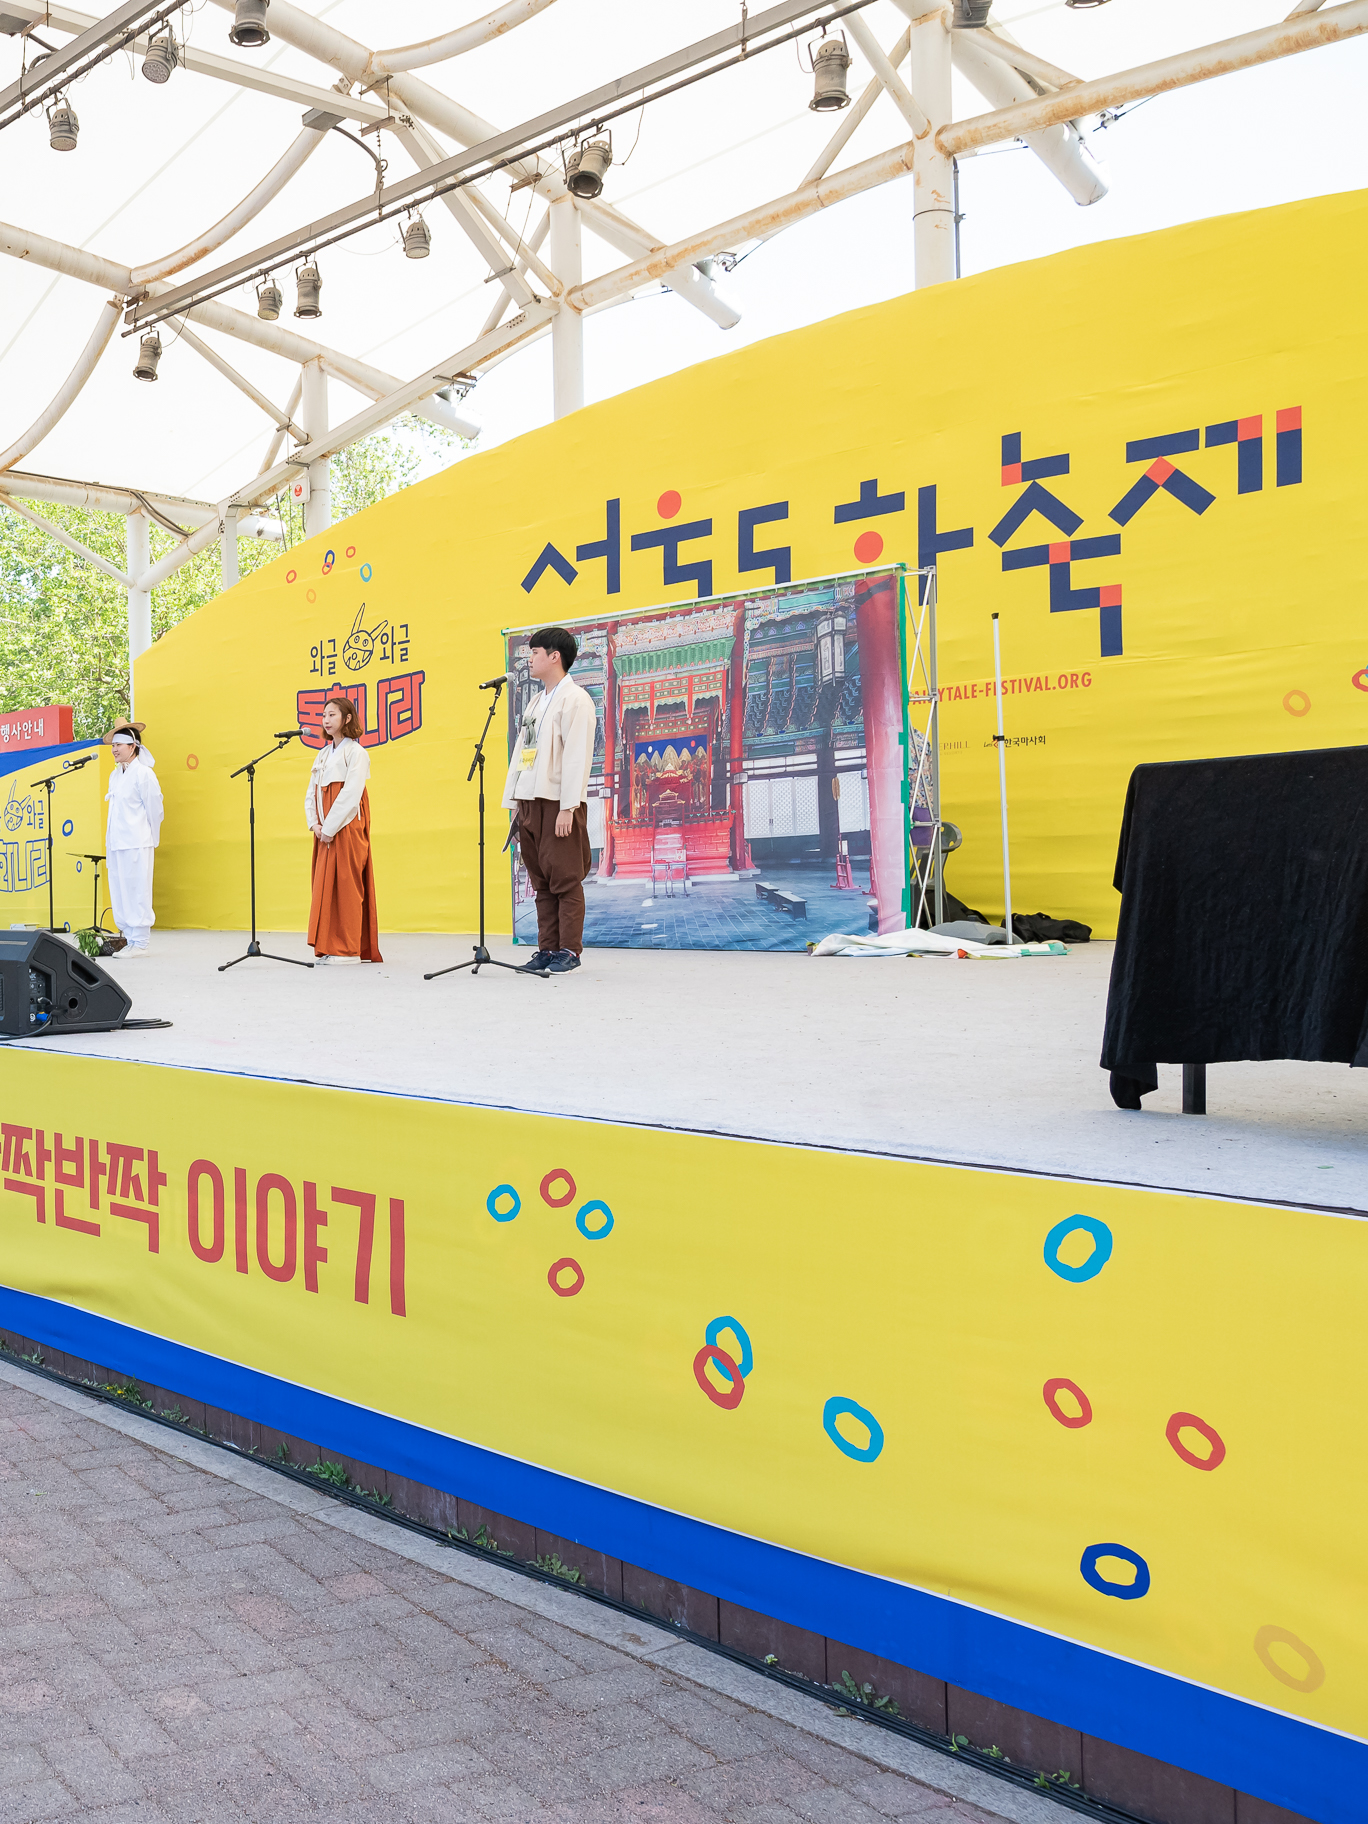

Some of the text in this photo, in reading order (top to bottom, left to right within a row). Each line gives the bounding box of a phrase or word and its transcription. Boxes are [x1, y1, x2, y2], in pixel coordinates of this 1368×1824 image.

[310, 624, 411, 677] 와글 와글
[0, 717, 45, 743] 행사안내
[1004, 735, 1046, 748] 한국마사회
[26, 800, 45, 829] 와글
[187, 1158, 407, 1318] 이야기
